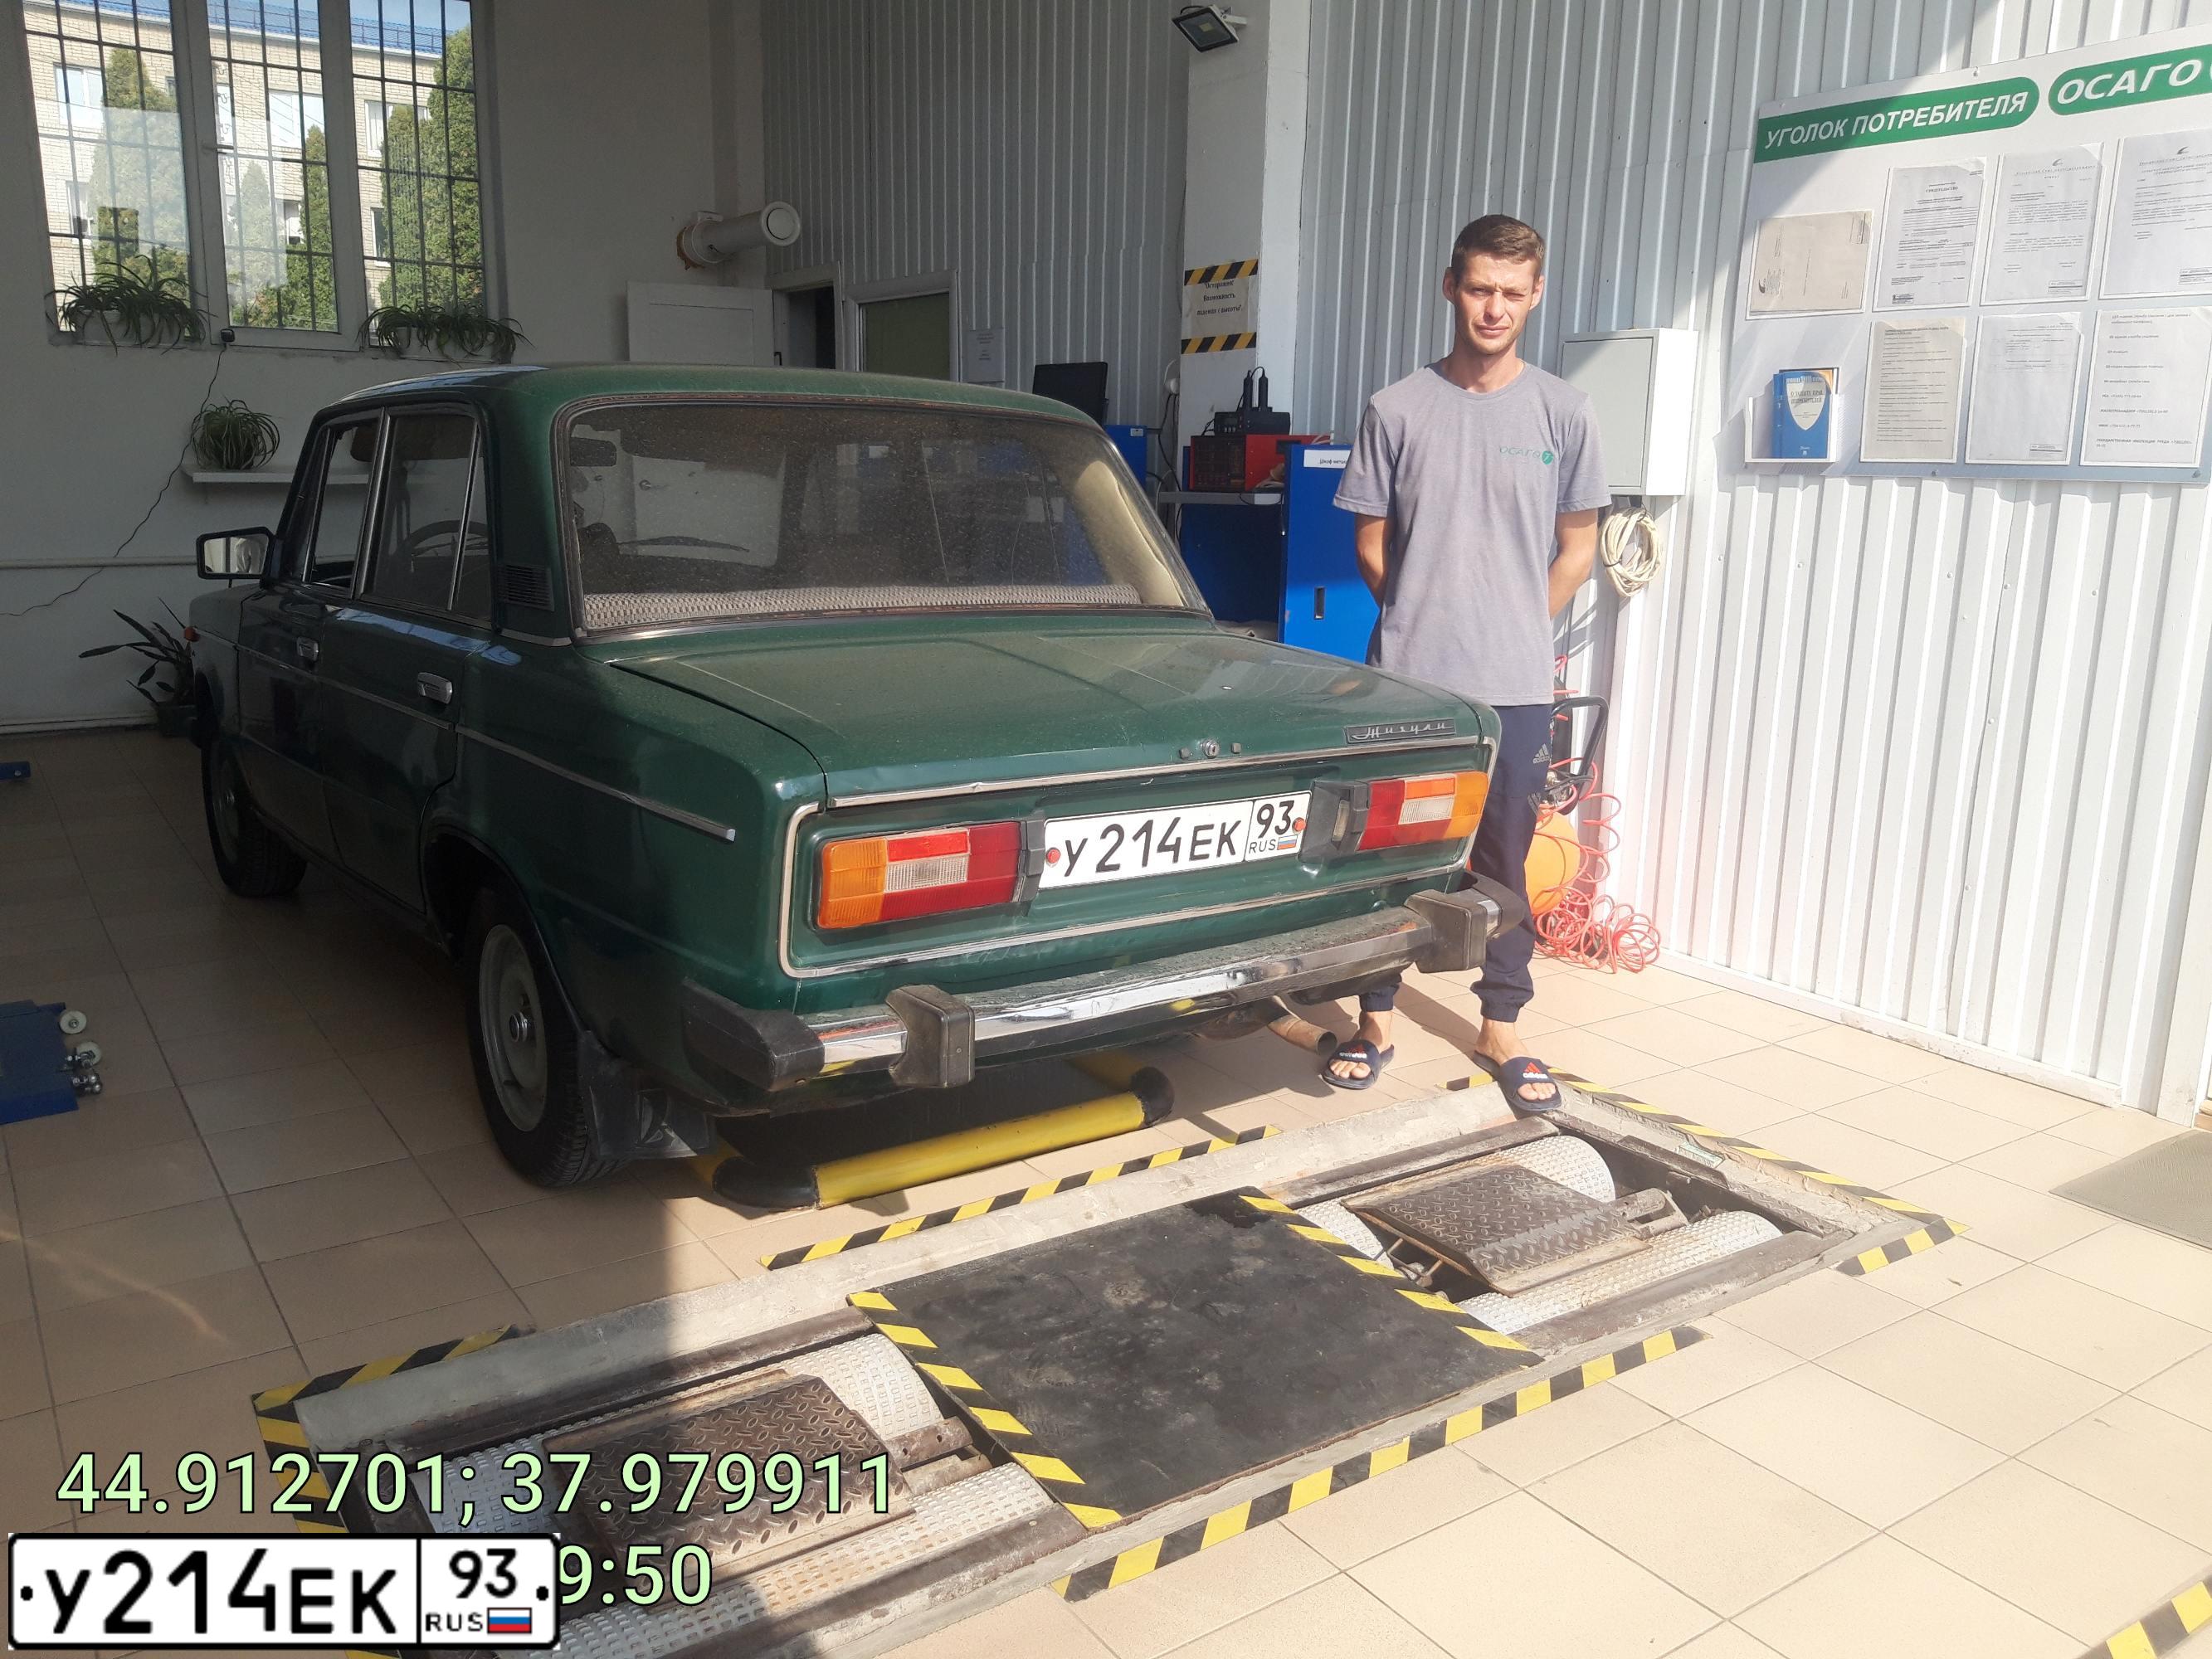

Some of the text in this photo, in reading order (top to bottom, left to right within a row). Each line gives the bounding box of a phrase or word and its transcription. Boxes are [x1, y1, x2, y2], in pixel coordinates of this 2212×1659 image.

[2056, 59, 2203, 106] ОСАГО
[1763, 91, 2029, 150] УГОЛОК ПОТРЕБИТЕЛЯ
[1351, 722, 1454, 741] Жигули
[1256, 800, 1296, 839] 93
[1248, 839, 1277, 854] RUS
